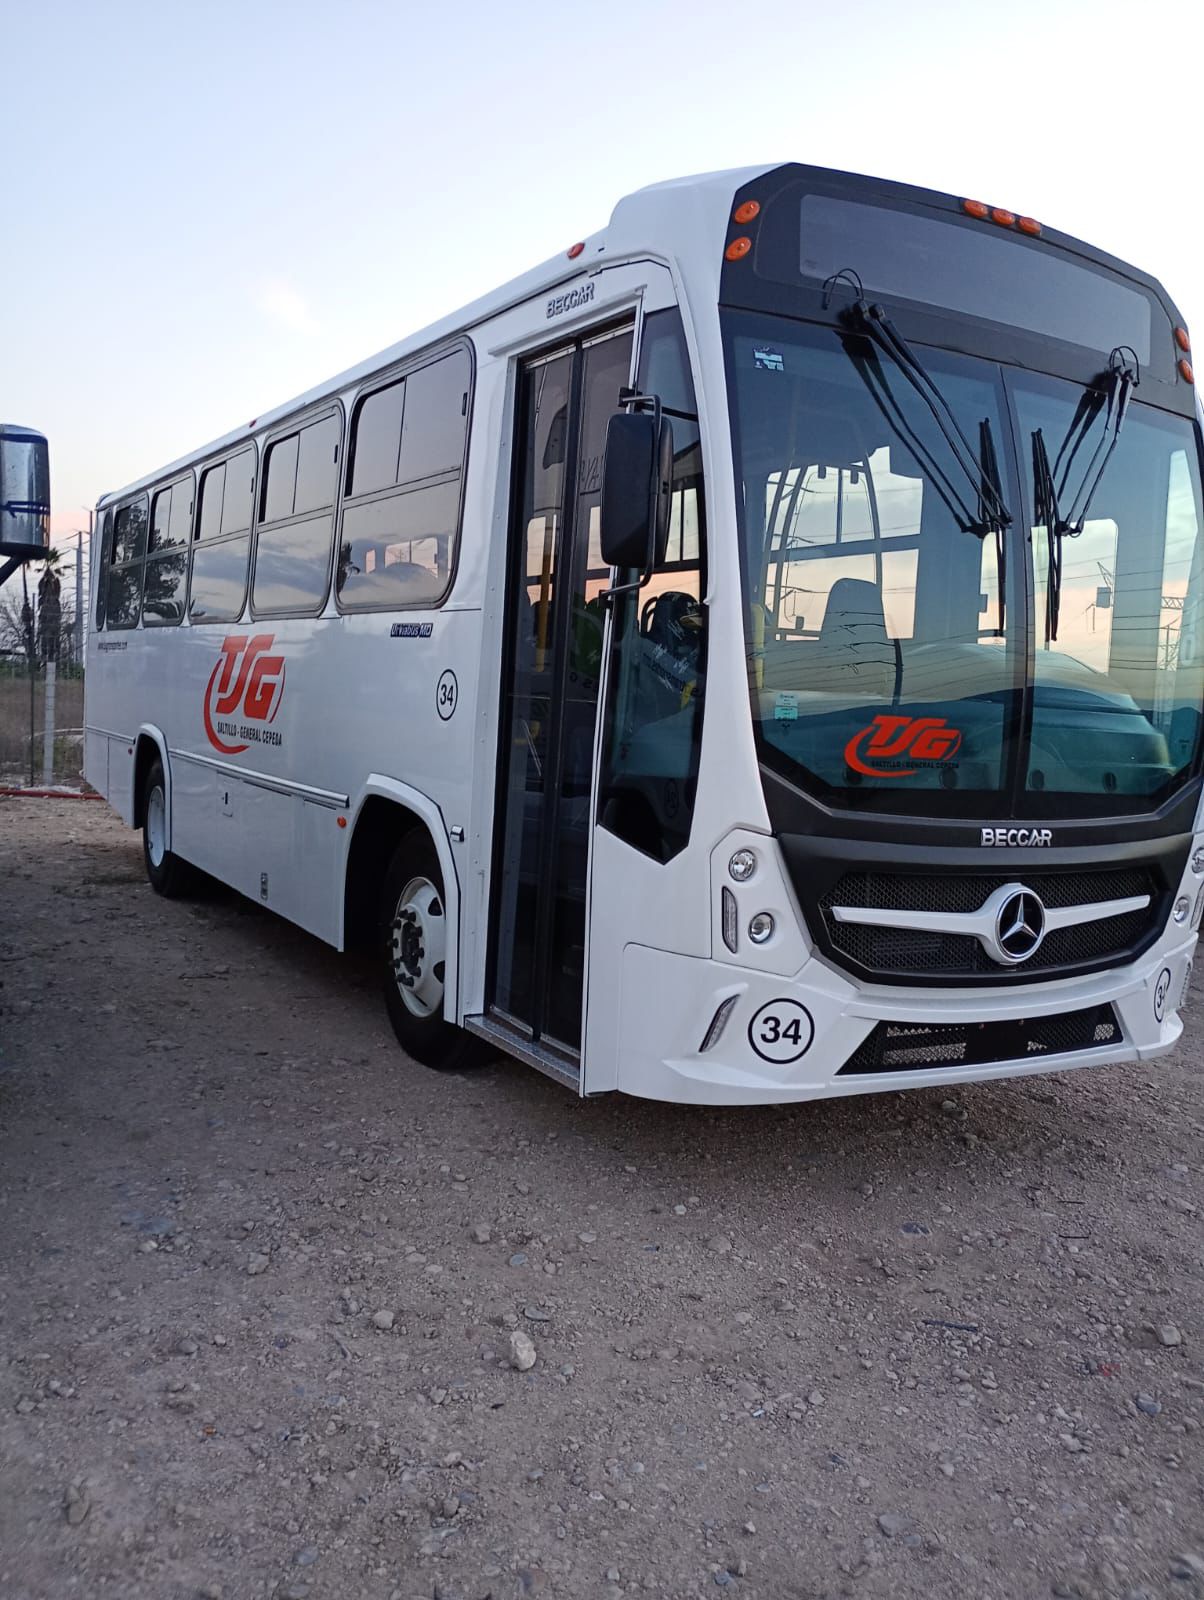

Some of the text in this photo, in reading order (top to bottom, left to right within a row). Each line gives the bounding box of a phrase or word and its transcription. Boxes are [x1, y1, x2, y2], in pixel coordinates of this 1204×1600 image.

[546, 282, 595, 319] BECCAR
[216, 634, 285, 721] TSG
[440, 683, 454, 706] 34
[217, 721, 237, 738] SALTILLO
[240, 726, 262, 742] GENERAL
[865, 714, 961, 759] TSG
[980, 827, 1053, 847] BECCAR
[760, 1016, 802, 1046] 34
